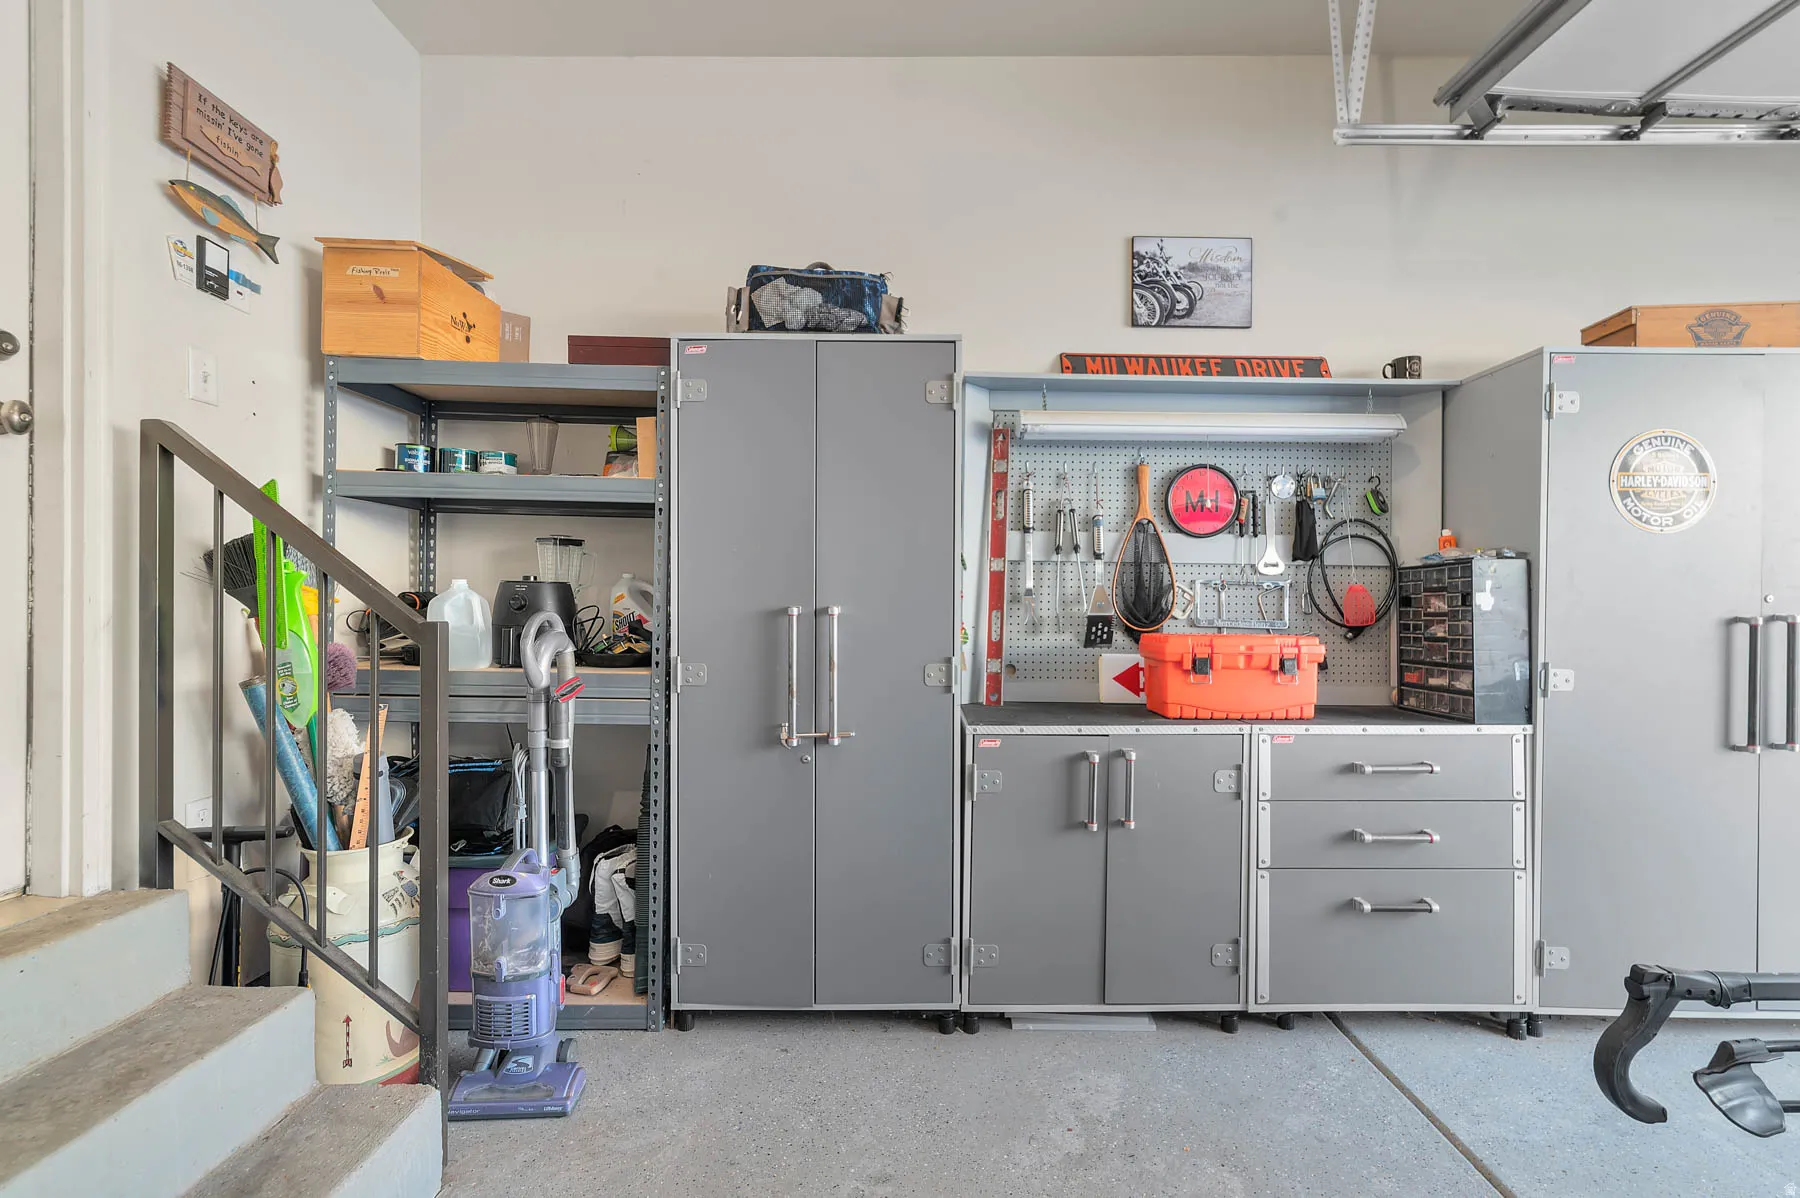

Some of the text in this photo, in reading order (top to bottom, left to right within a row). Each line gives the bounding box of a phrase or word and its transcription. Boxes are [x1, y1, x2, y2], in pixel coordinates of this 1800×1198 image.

[197, 92, 264, 146] If the keys are
[246, 143, 264, 158] gone
[1234, 359, 1305, 378] DRIVE
[1632, 436, 1695, 456] GENUINE
[1620, 475, 1708, 489] HARLEY-DAVIDSON
[1622, 497, 1705, 527] MOTOR OIL
[492, 877, 511, 885] Shark
